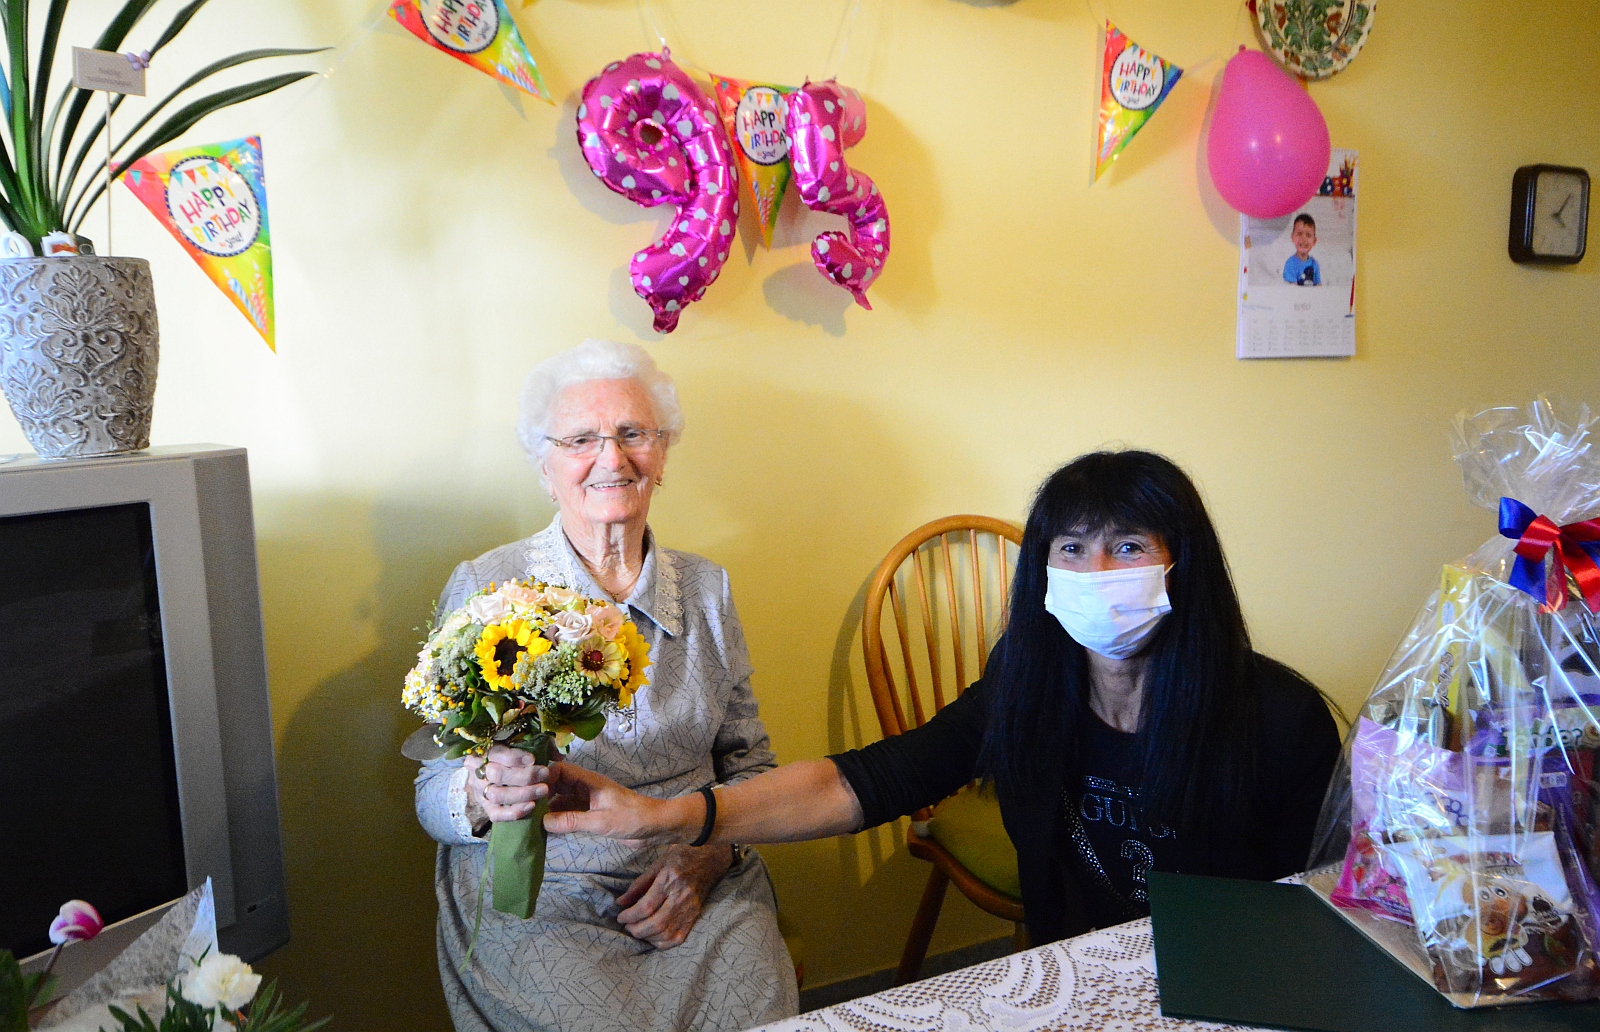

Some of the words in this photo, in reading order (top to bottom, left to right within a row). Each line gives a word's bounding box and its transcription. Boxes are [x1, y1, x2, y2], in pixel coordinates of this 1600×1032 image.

[450, 0, 487, 48] BIRTHDA
[1119, 61, 1157, 81] HAPPY
[1114, 77, 1158, 98] BIRTHDAY
[742, 108, 783, 131] HAPPY
[743, 128, 786, 149] BIRTHDA
[179, 177, 235, 224] HAPPY
[190, 198, 252, 244] BIRTHDAY
